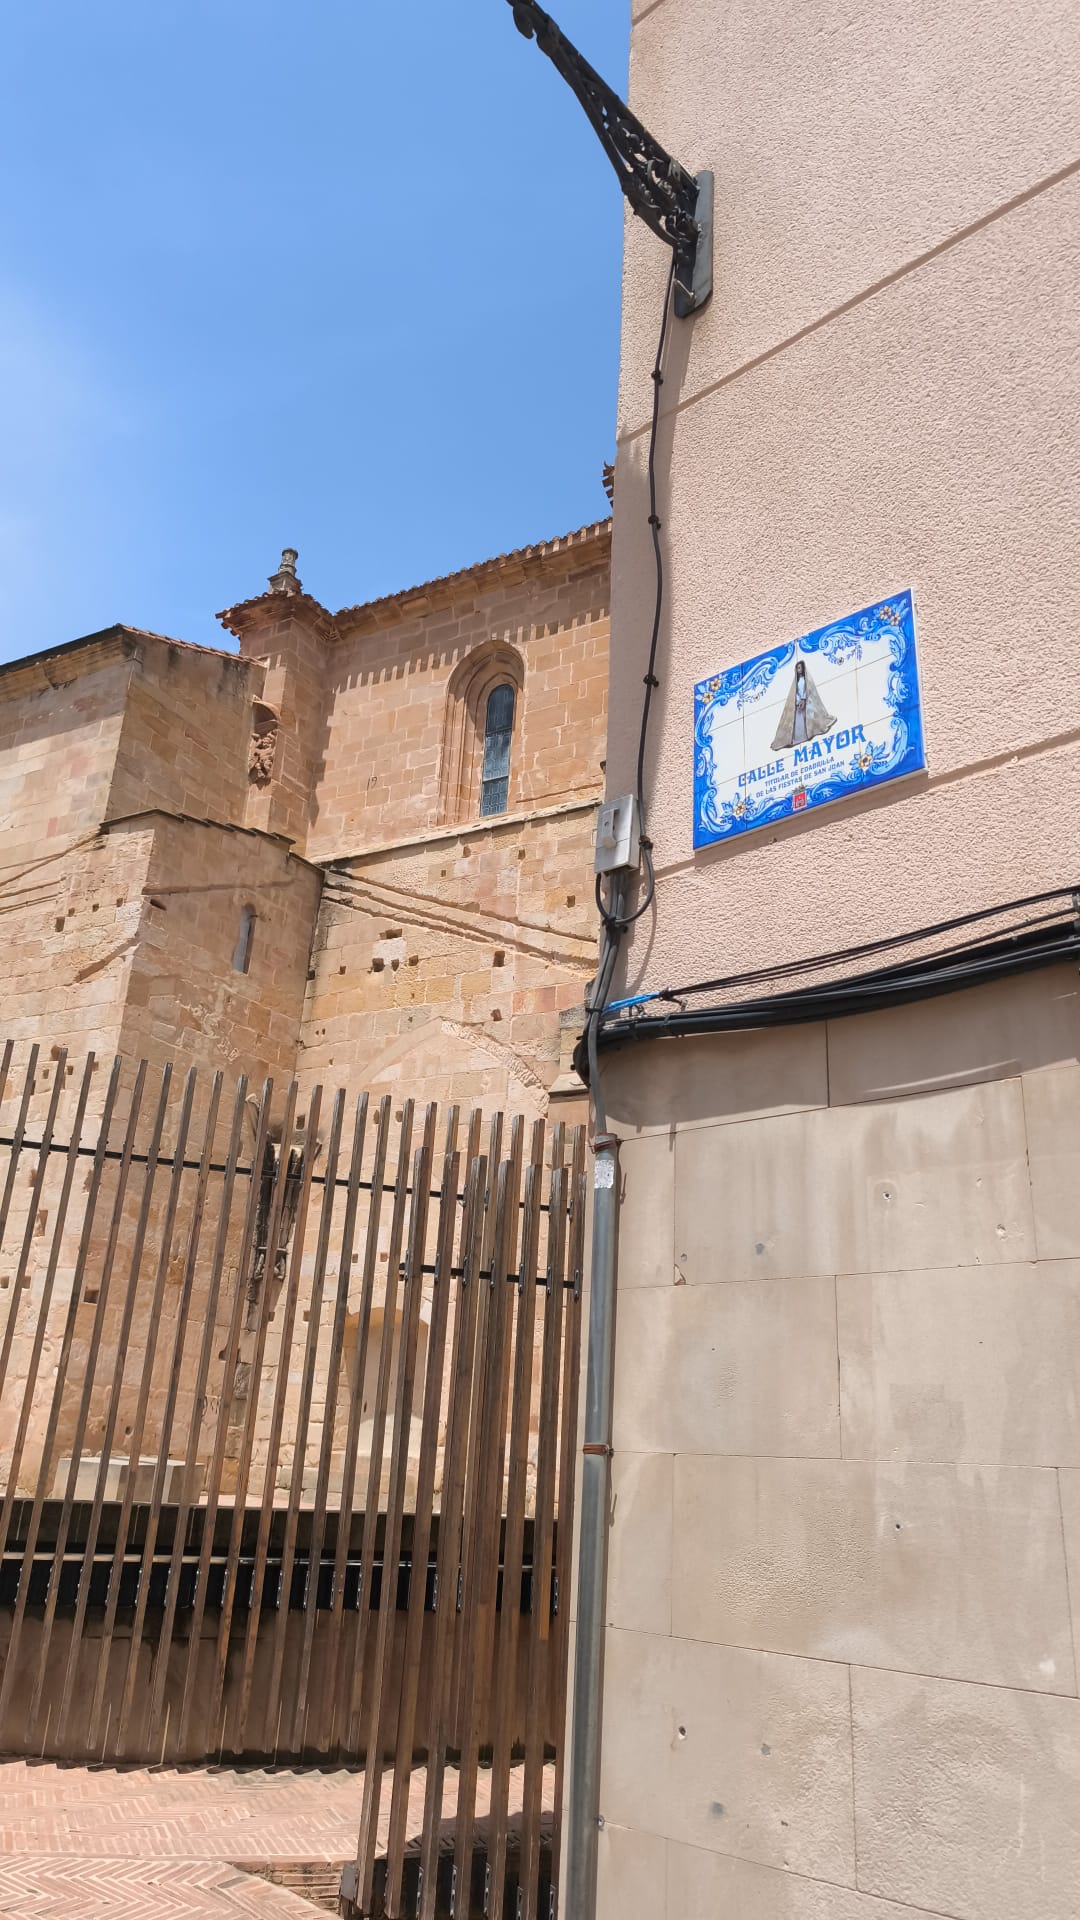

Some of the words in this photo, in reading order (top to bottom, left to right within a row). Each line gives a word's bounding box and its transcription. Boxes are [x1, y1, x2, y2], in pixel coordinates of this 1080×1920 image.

[738, 758, 785, 787] CALLE
[793, 723, 867, 766] MAYOR
[764, 773, 789, 787] TITULAR
[790, 770, 799, 778] DE
[800, 756, 835, 774] CUADRILLA
[755, 790, 764, 798] DE
[765, 785, 777, 795] LAS
[778, 775, 802, 790] FIESTAS
[803, 772, 812, 780] DE
[813, 767, 827, 777] SAN
[828, 760, 845, 773] JUAN
